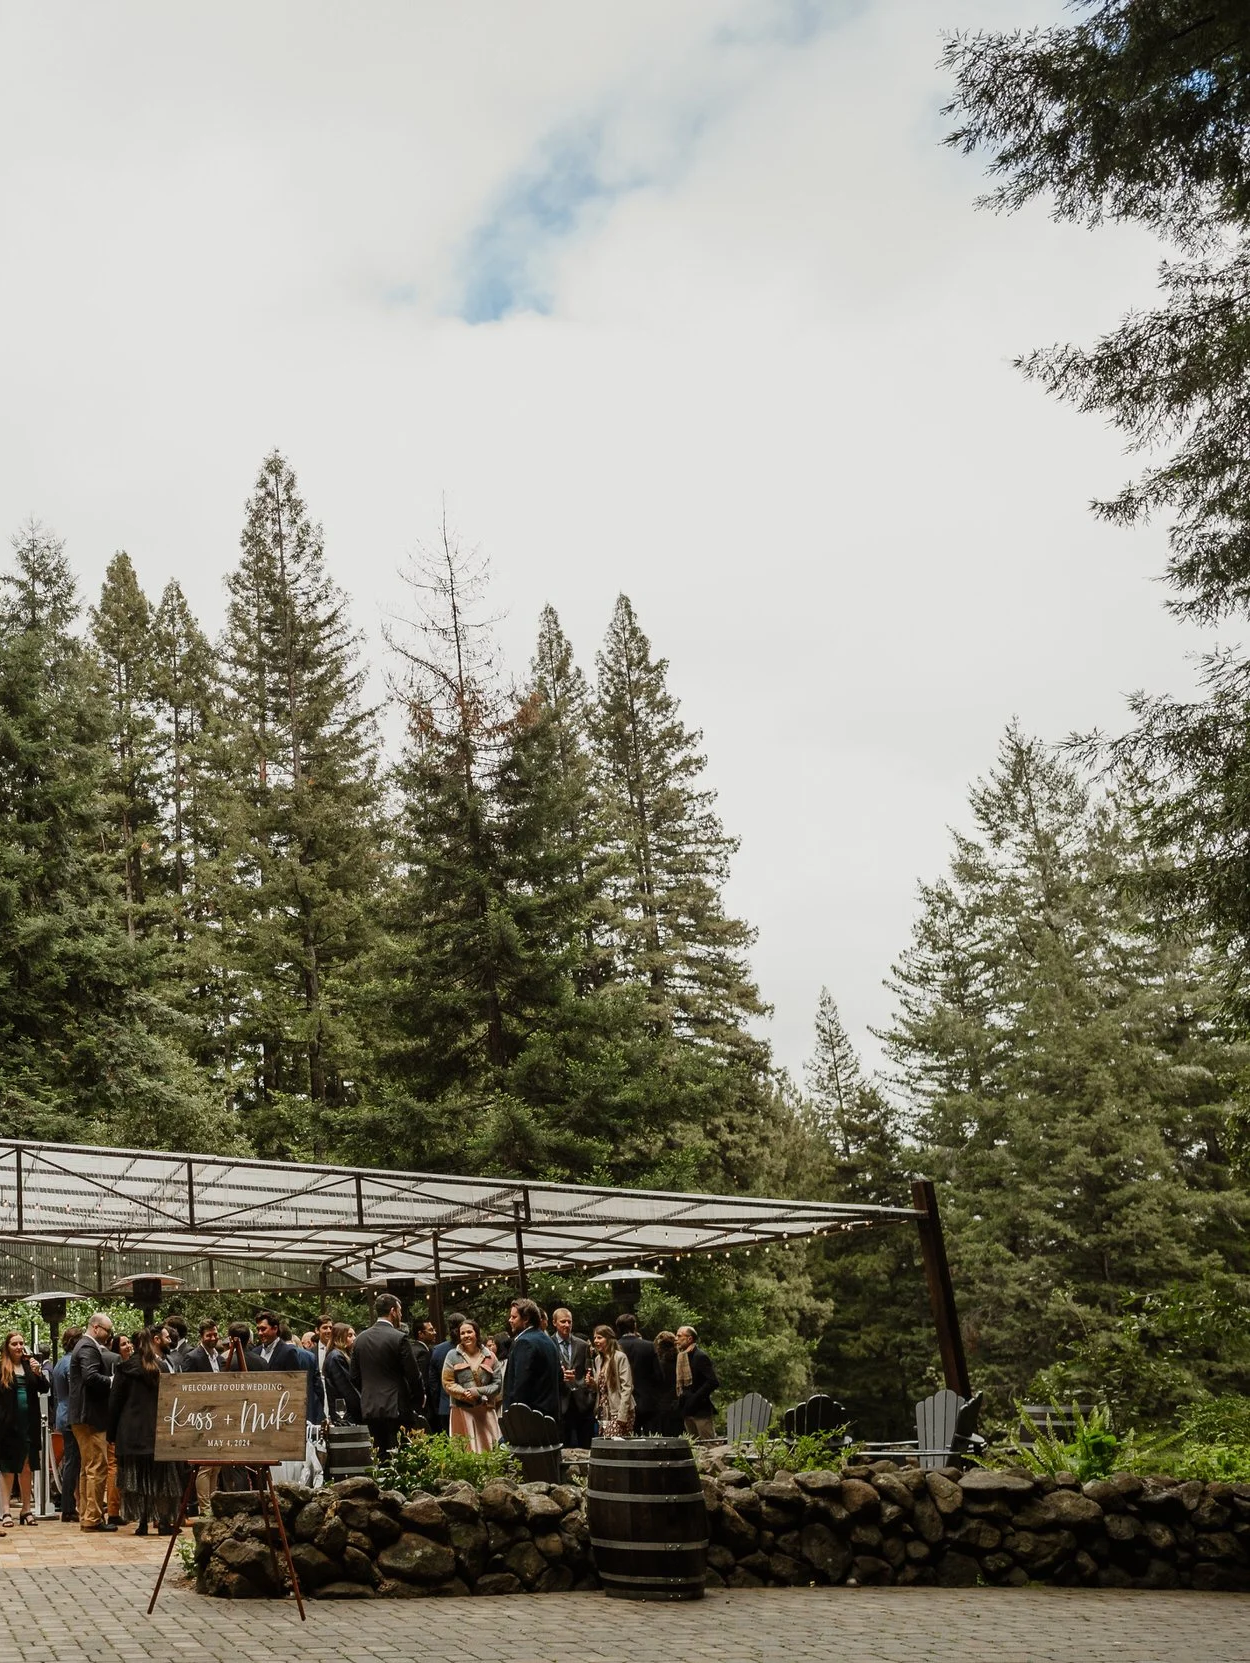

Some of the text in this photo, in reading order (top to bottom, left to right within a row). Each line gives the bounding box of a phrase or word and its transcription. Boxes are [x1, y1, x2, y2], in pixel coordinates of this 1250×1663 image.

[181, 1383, 282, 1392] WELCOME TO OUR WEDDING
[163, 1391, 298, 1436] Kass + Mike
[207, 1439, 224, 1447] MAY
[234, 1439, 250, 1447] 2024
